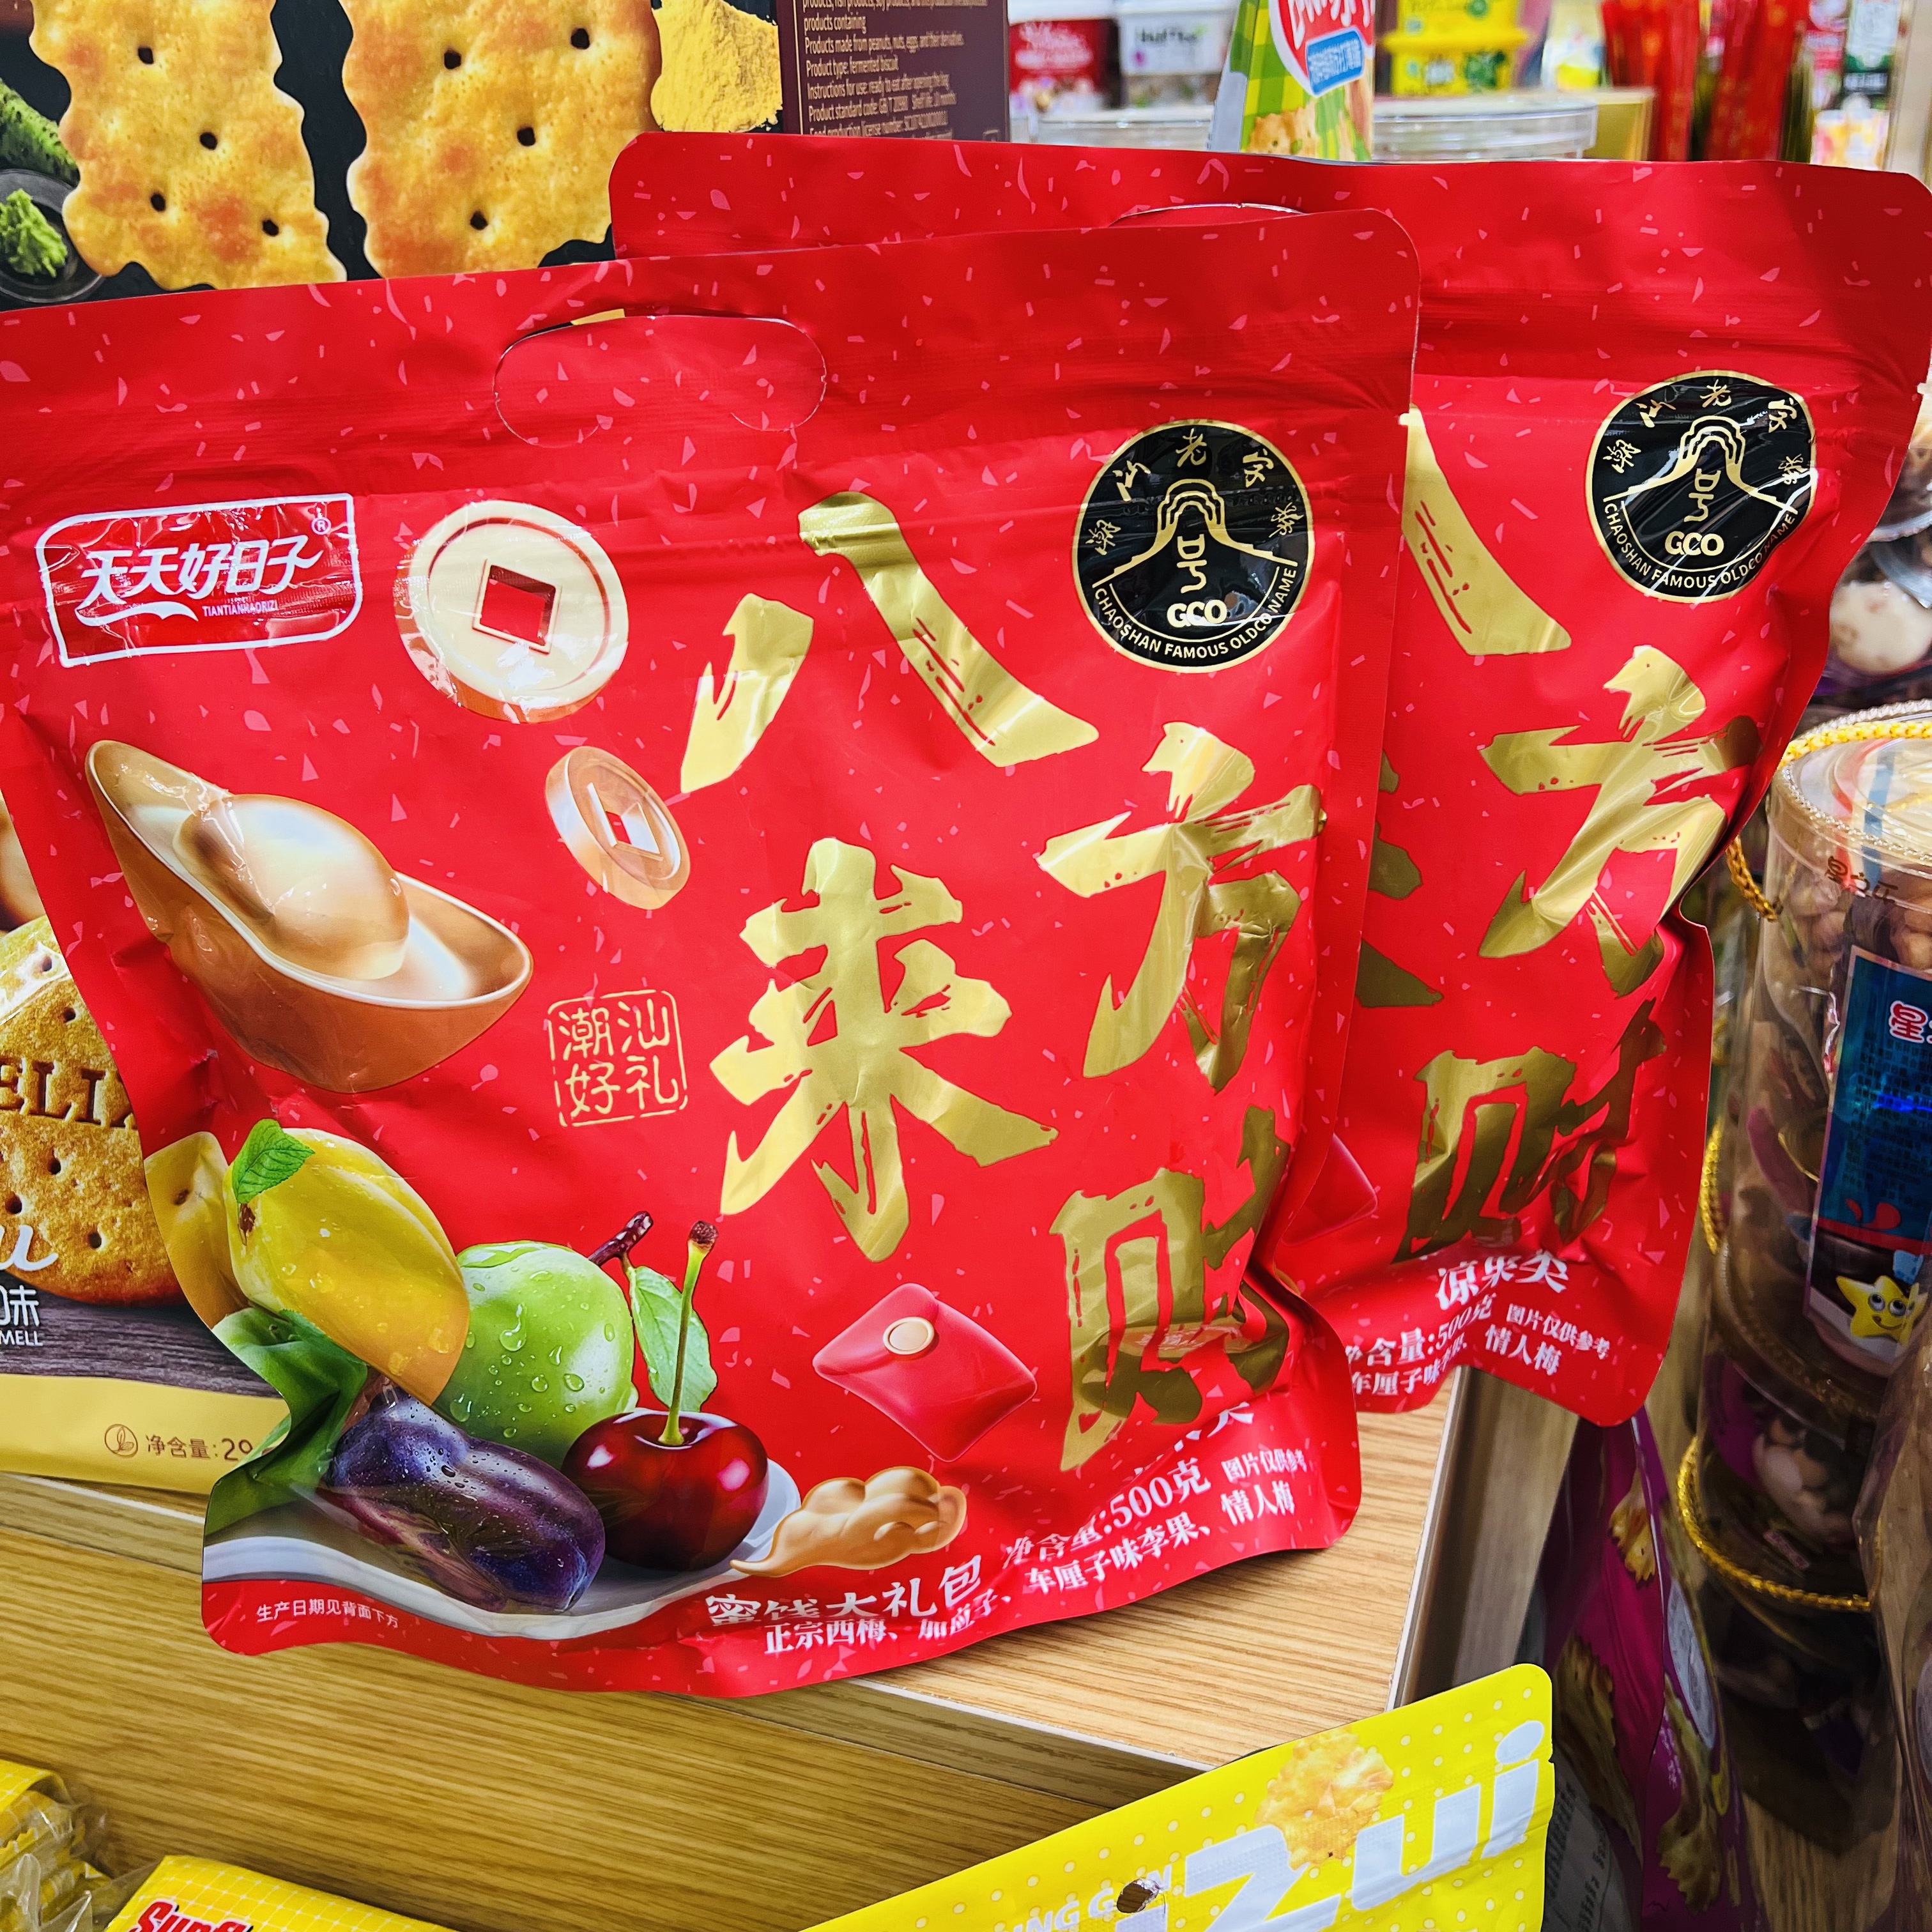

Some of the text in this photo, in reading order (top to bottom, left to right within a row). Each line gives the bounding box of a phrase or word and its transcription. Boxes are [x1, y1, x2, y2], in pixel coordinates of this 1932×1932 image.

[804, 13, 833, 36] products
[805, 37, 834, 54] Products
[835, 34, 852, 52] made
[806, 58, 833, 77] Product
[807, 80, 845, 100] Instructions
[809, 103, 834, 122] Product
[1604, 502, 1650, 576] CHAOSHAN
[1652, 567, 1718, 589] FAMOUS
[1763, 512, 1797, 554] NAME
[1664, 531, 1724, 556] GCO
[1094, 587, 1162, 654] CHAOSHAN
[1164, 641, 1229, 659] FAMOUS
[1270, 568, 1298, 613] NAME
[1167, 599, 1228, 629] GCO
[1506, 1302, 1611, 1360] 图片仅供参考
[1222, 1448, 1307, 1483] 图片仅供参考
[256, 1598, 399, 1628] 生产日期见背面下方
[1087, 1864, 1173, 1919] GN
